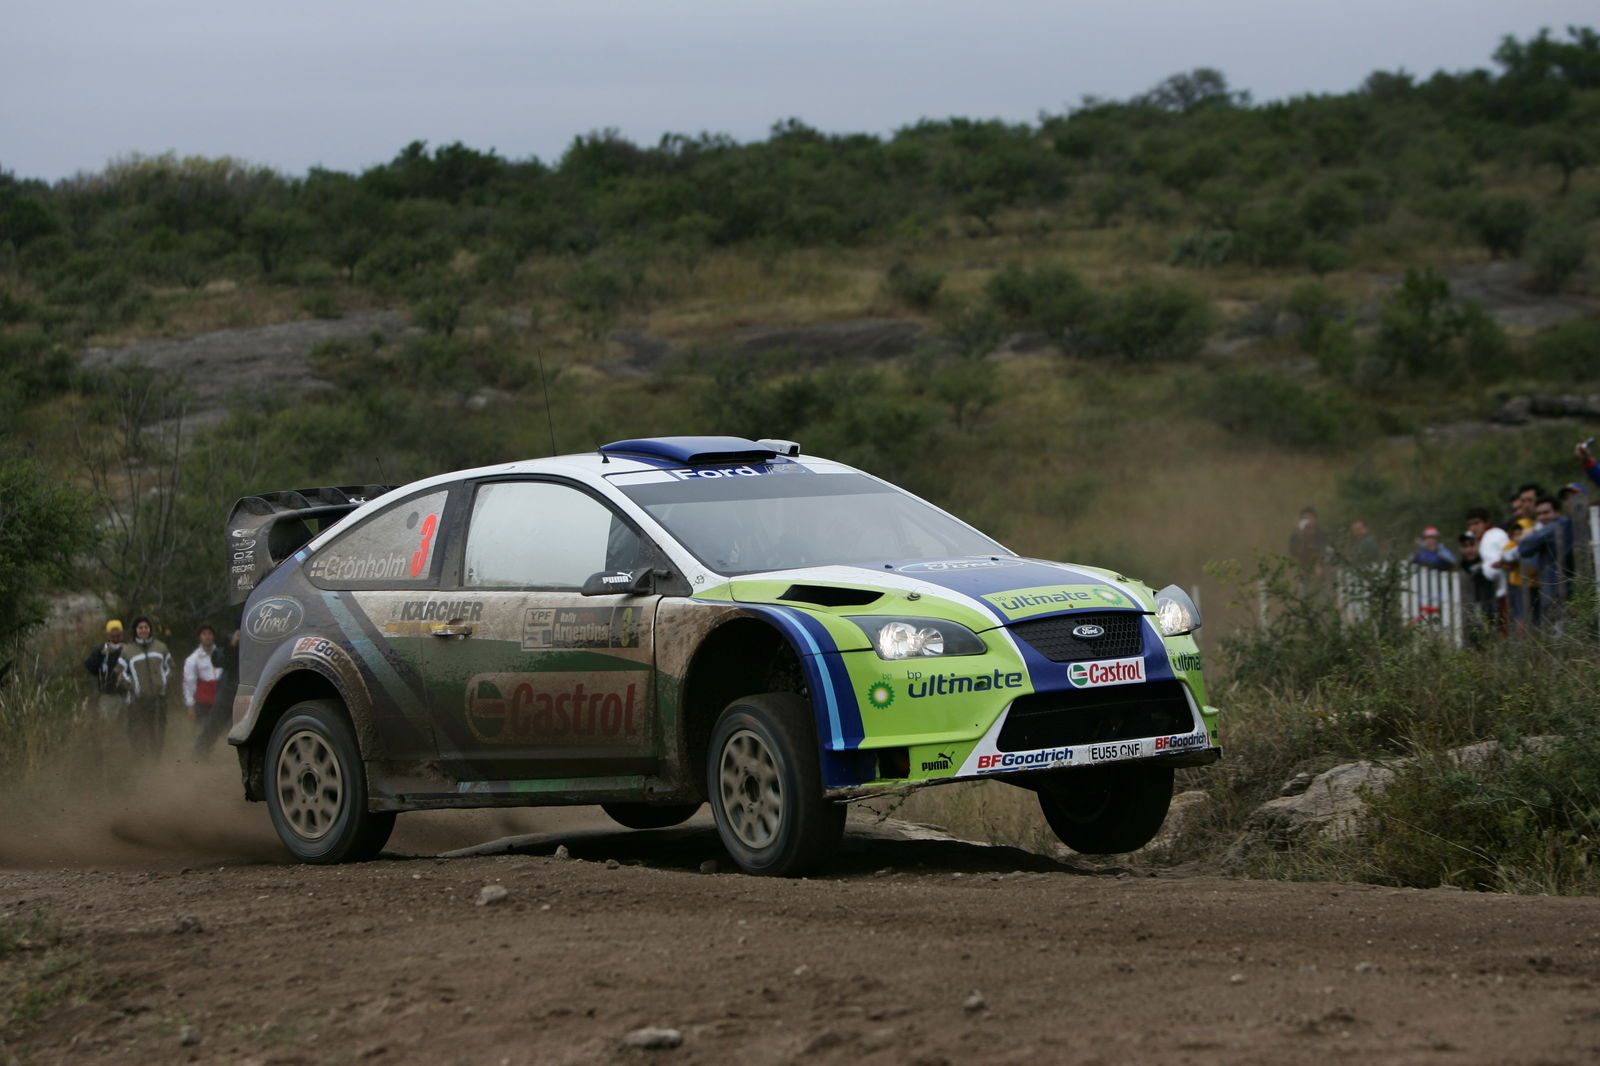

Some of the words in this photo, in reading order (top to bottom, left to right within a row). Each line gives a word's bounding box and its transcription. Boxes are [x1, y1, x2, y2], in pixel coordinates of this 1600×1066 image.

[671, 466, 762, 480] Ford
[409, 514, 437, 577] 3
[324, 552, 407, 580] Grönholm
[1001, 590, 1092, 610] ultimate
[253, 603, 293, 634] Ford
[401, 601, 484, 621] KÄRCHER
[530, 611, 552, 620] YPF
[1081, 626, 1099, 635] Ford
[882, 672, 893, 681] bp
[907, 670, 922, 681] bp
[1089, 661, 1142, 684] Castrol
[908, 668, 1023, 698] ultimate
[510, 682, 637, 737] Castrol
[1155, 732, 1207, 750] BFGoodrich
[978, 748, 1073, 769] BFGoodrich
[1091, 745, 1118, 760] EU55
[1120, 743, 1140, 757] CNF
